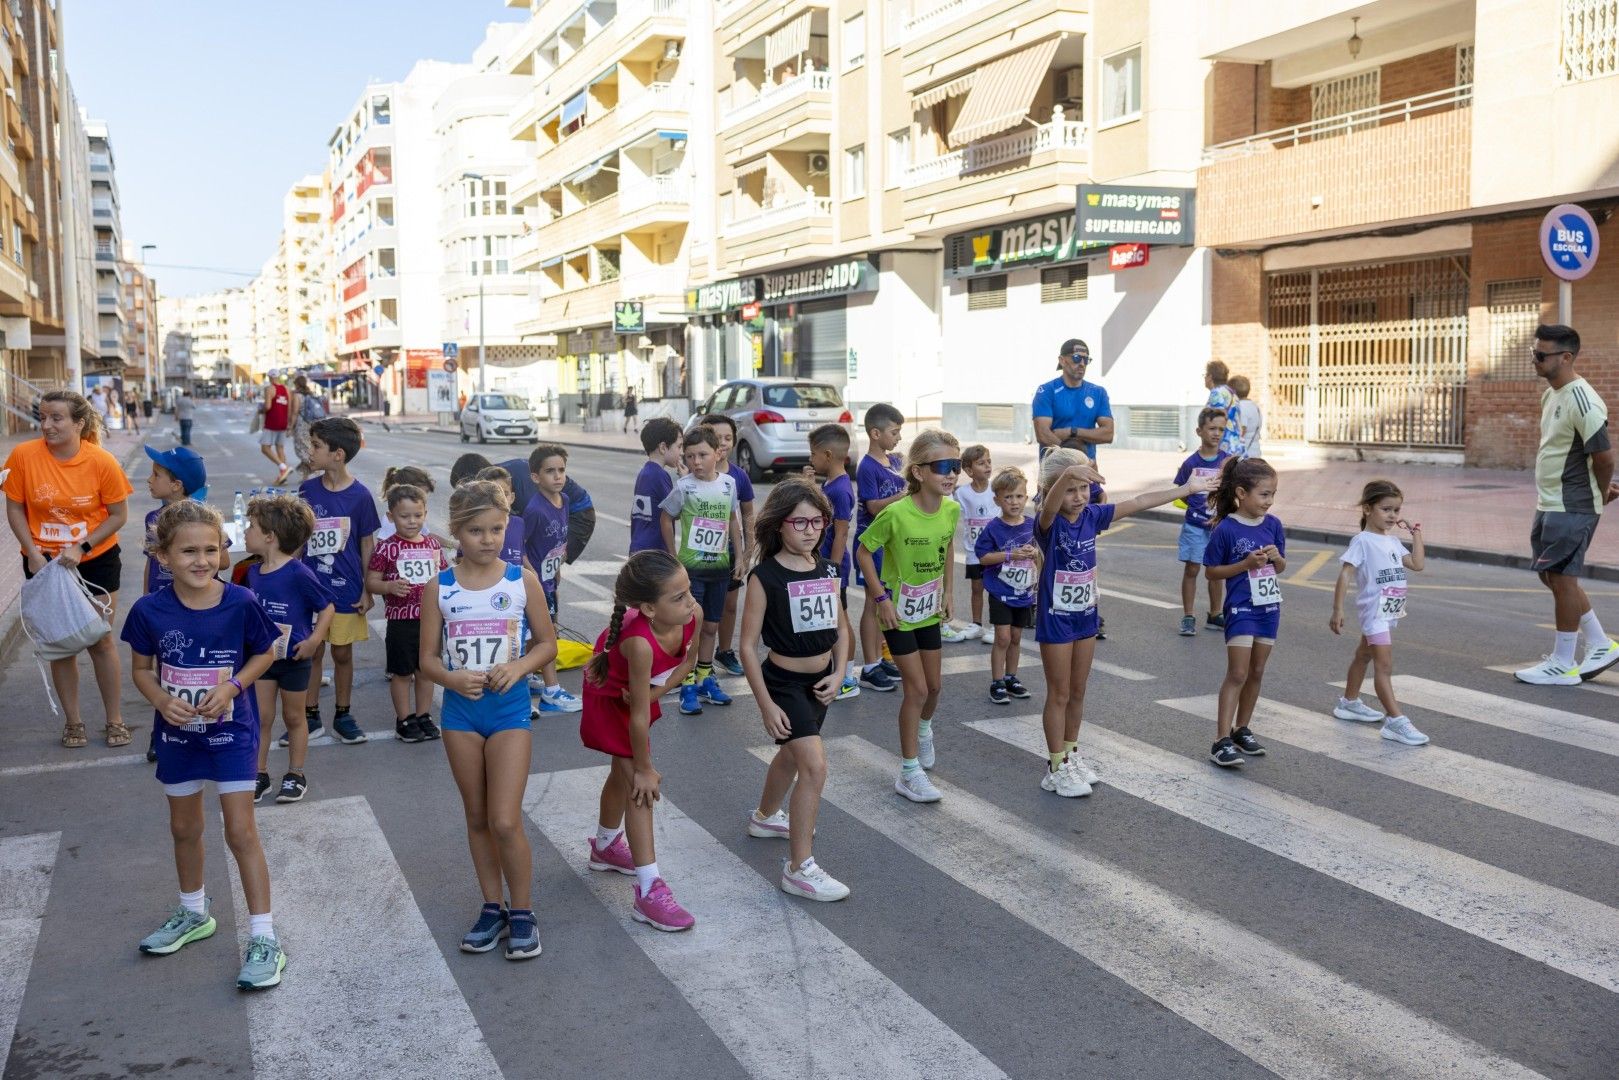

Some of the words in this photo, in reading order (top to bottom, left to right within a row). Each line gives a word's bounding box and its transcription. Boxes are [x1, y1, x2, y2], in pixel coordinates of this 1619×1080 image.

[1101, 193, 1181, 211] masymas
[1085, 219, 1182, 235] SUPERMERCADO
[1557, 229, 1584, 244] BUS
[1000, 215, 1076, 260] masy
[1111, 245, 1145, 267] basic
[1552, 243, 1588, 254] ESCOLAR
[763, 261, 860, 300] SUPERMERCADO
[698, 279, 756, 311] masymas
[311, 530, 337, 549] 538
[694, 528, 723, 546] 507
[404, 560, 432, 578] 531
[545, 557, 561, 573] 50
[1005, 568, 1028, 584] 501
[1060, 583, 1091, 605] 528
[800, 595, 834, 622] 541
[904, 593, 934, 617] 544
[455, 637, 503, 666] 517
